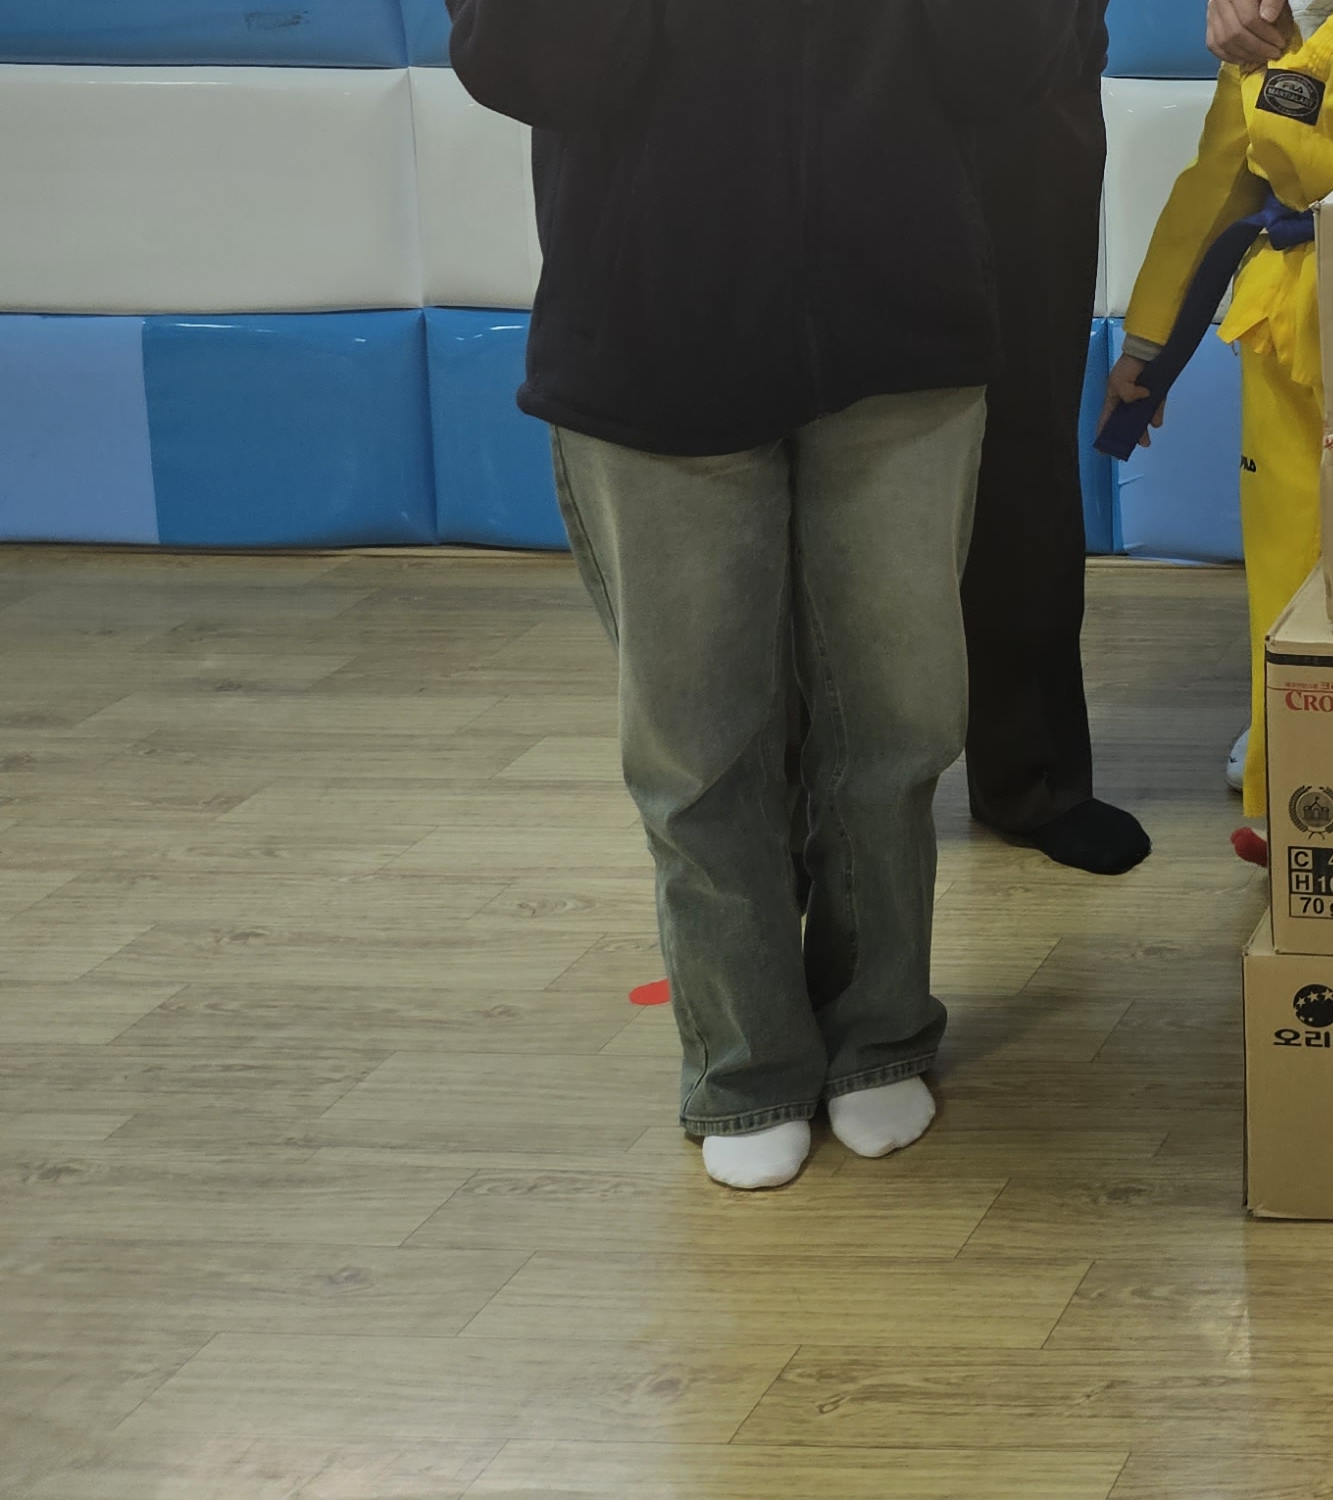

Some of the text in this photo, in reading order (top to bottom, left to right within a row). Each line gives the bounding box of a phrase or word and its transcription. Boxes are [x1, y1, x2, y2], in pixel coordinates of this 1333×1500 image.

[1282, 82, 1304, 94] FILA
[1294, 851, 1309, 867] C
[1295, 874, 1309, 891] H
